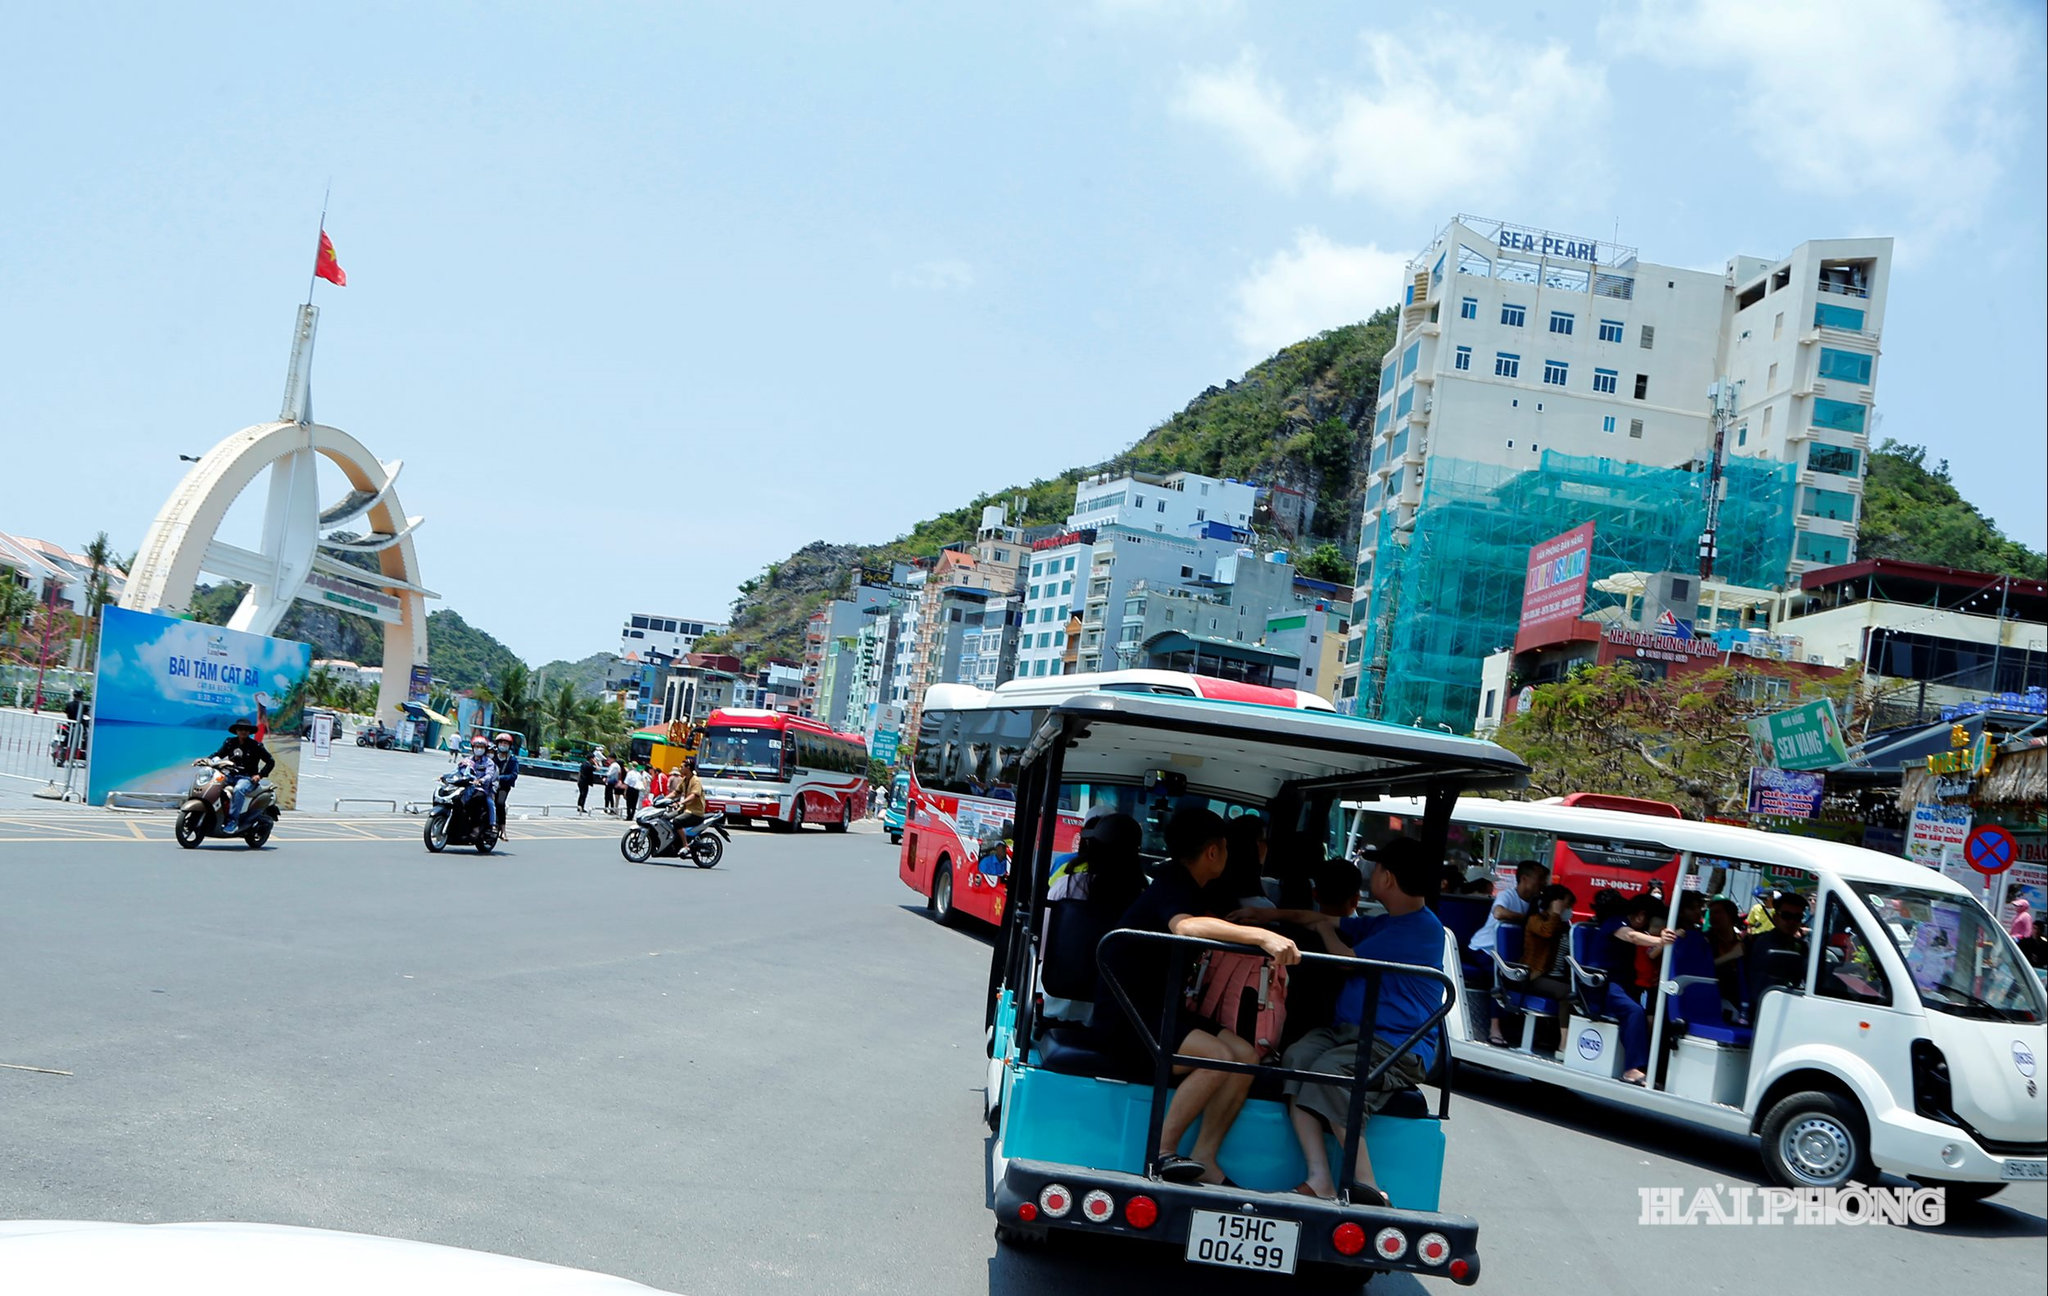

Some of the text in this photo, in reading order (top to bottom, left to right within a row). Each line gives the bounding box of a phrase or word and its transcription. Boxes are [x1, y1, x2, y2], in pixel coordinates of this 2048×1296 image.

[1499, 230, 1598, 262] SEA PEARL
[1551, 548, 1587, 586] ISLAND
[221, 663, 242, 685] CÁT
[1777, 727, 1823, 760] SEN VÀNG
[1198, 1238, 1284, 1269] 004.99
